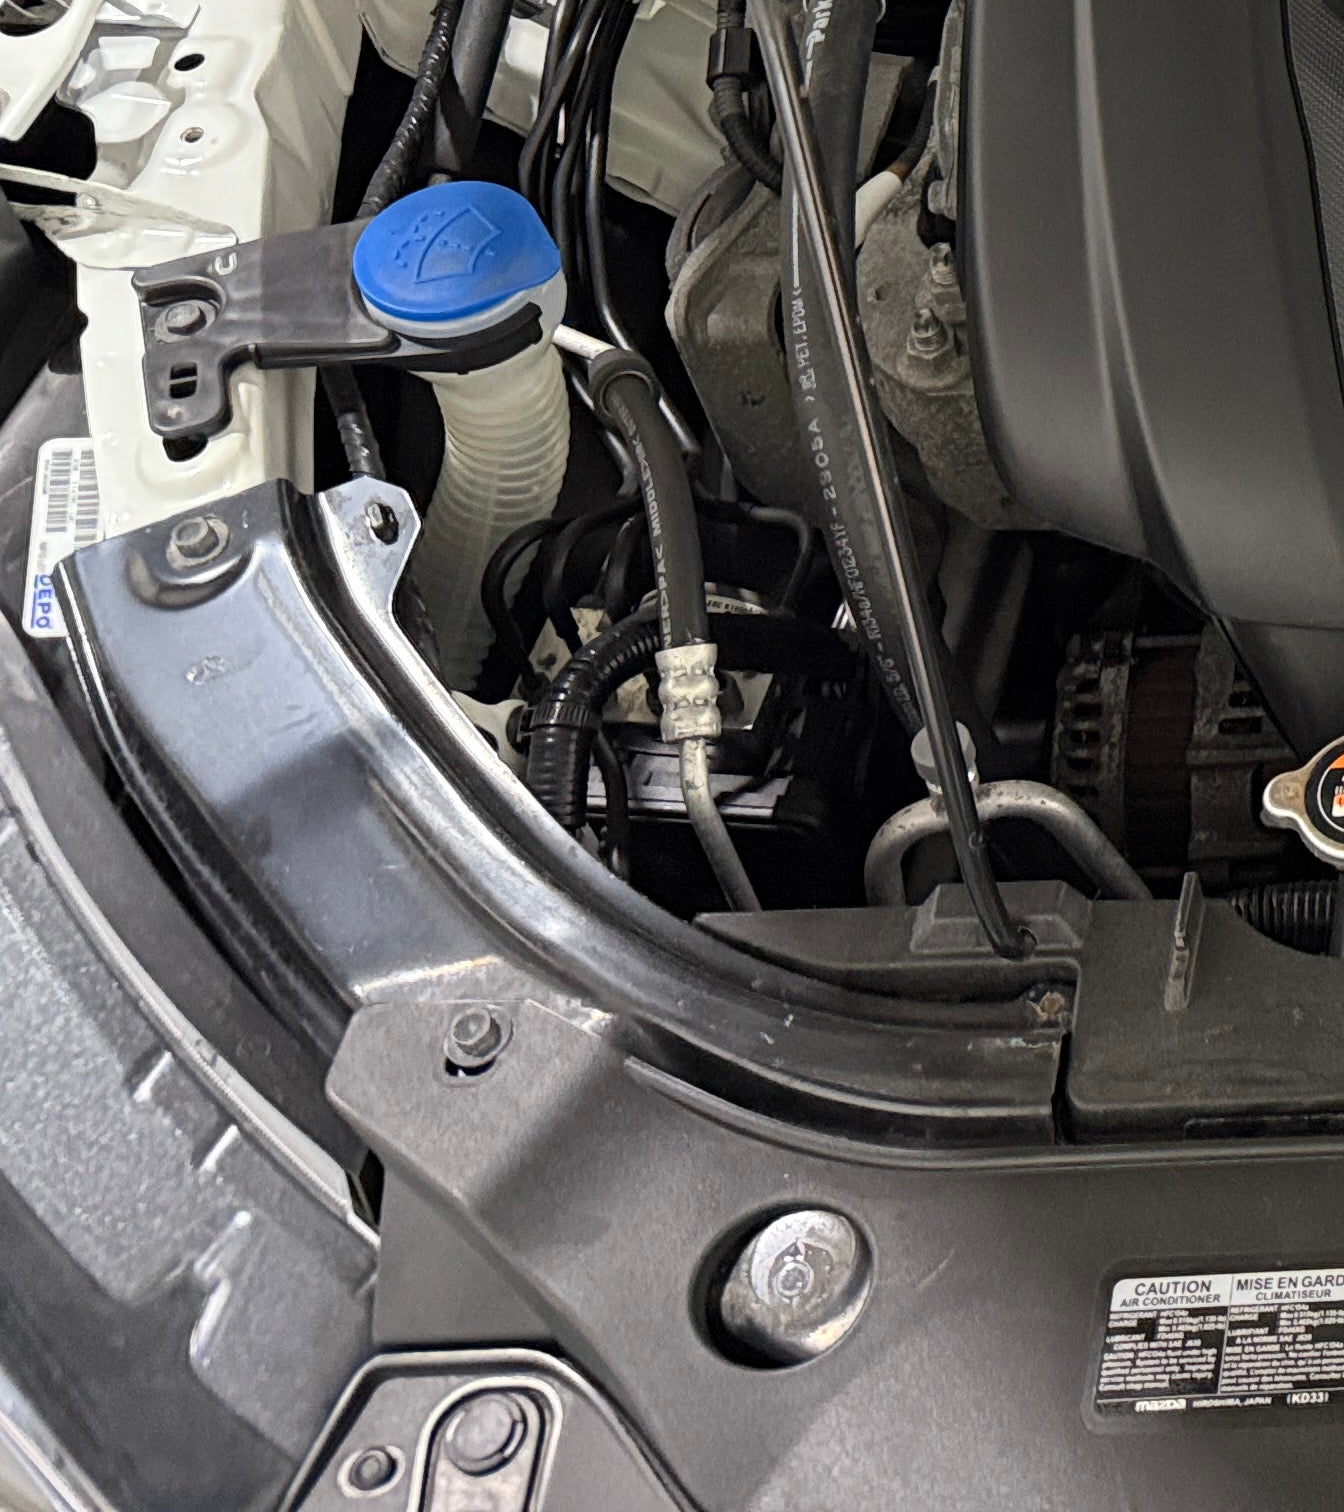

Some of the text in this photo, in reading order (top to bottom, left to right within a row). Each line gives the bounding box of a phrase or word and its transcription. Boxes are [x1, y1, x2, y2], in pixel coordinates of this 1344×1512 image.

[1134, 1280, 1211, 1294] CAUTION
[1237, 1278, 1273, 1291] MISE
[1278, 1278, 1297, 1288] EN
[1120, 1294, 1221, 1308] AIR CONDITIONER
[1256, 1289, 1331, 1300] CLIMATISEUR
[1287, 1393, 1328, 1404] (KD33)
